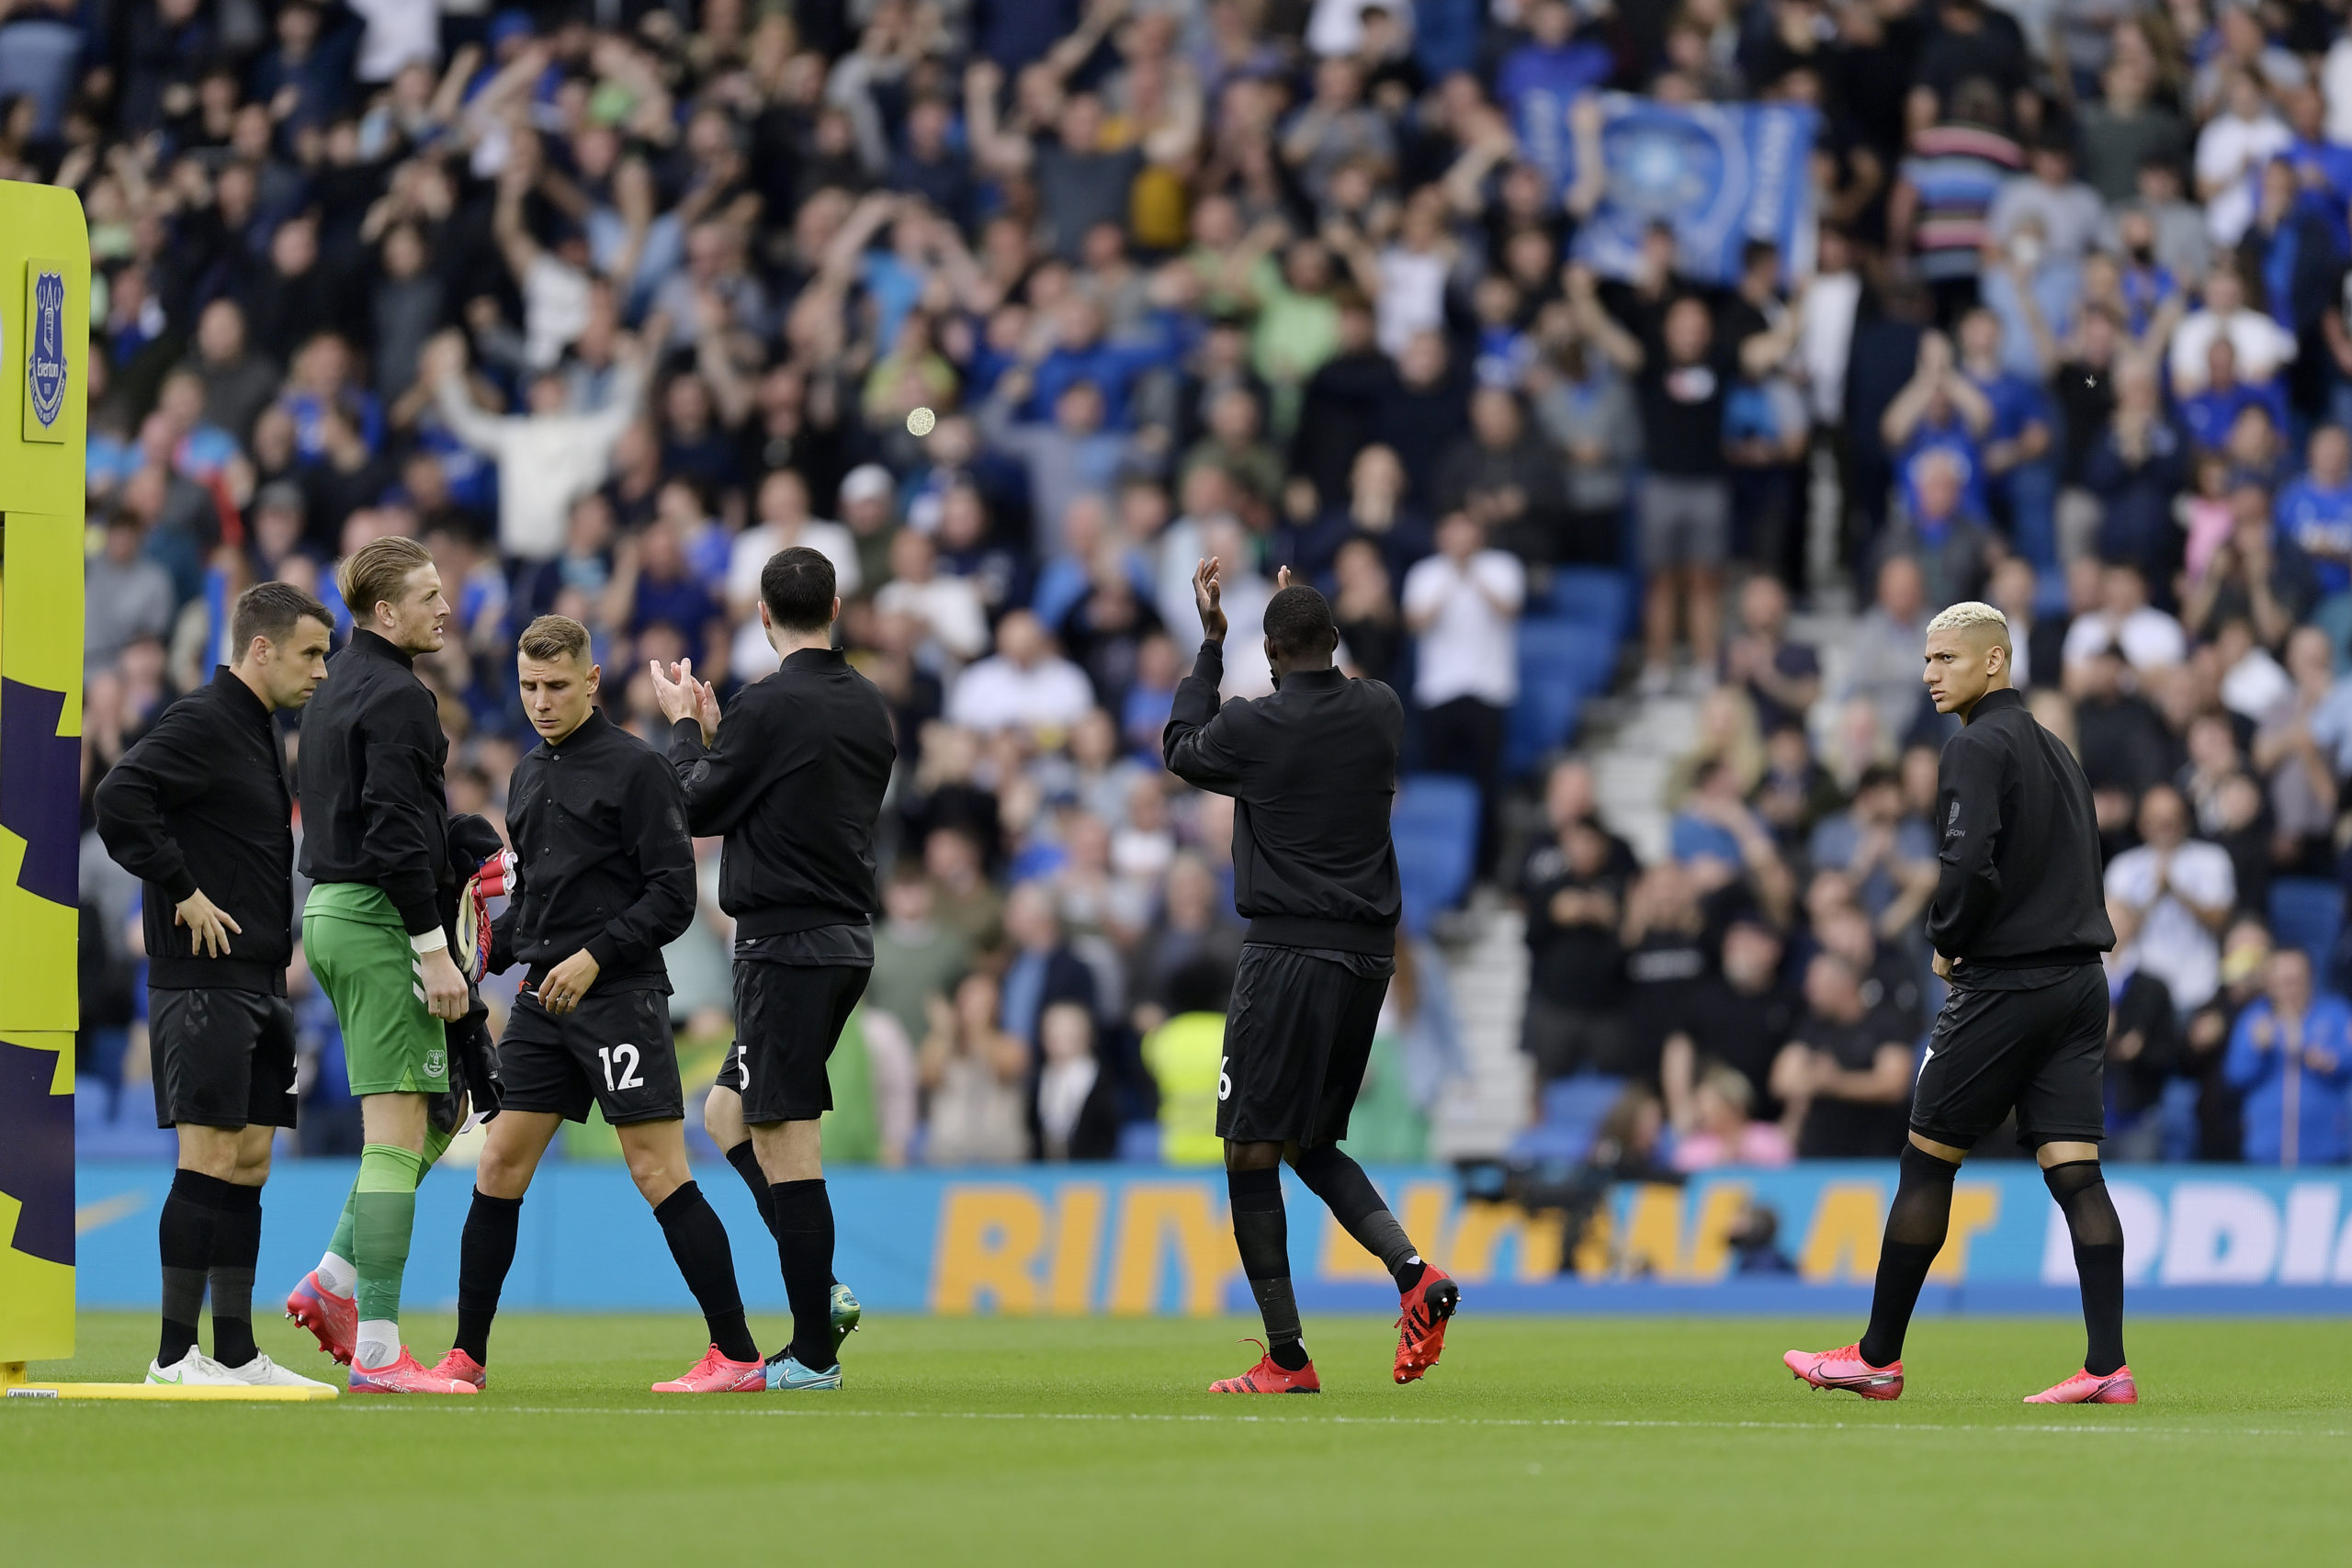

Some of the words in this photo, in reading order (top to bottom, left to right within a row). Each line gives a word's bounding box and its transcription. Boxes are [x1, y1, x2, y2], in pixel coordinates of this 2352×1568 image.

[598, 1043, 644, 1091] 12
[738, 1045, 751, 1090] 5
[1217, 1055, 1232, 1101] 6
[726, 1369, 760, 1392] ULTRA
